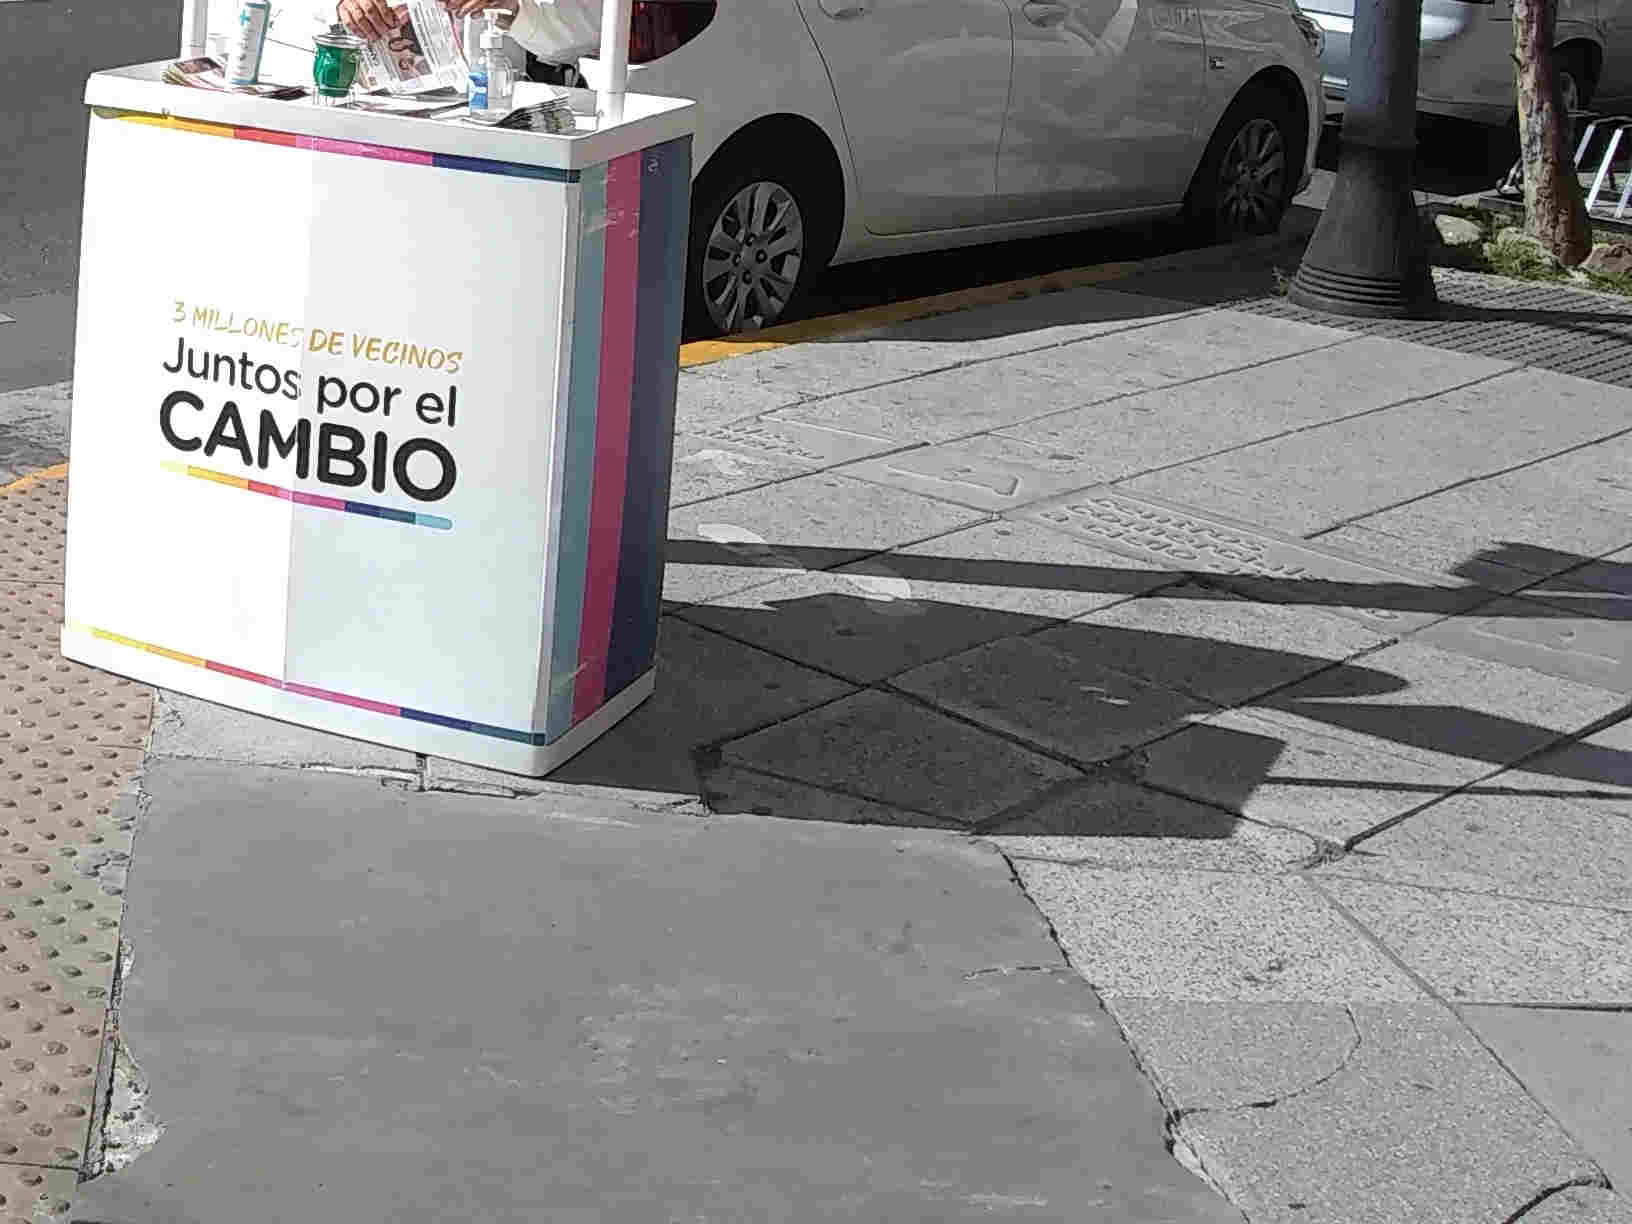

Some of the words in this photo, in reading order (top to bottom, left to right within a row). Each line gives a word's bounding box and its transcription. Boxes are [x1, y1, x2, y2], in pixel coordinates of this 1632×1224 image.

[162, 336, 303, 401] Juntos
[316, 374, 403, 417] por
[415, 384, 458, 428] el
[172, 301, 186, 323] 3
[191, 306, 305, 348] MILLONES
[307, 328, 345, 356] DE
[352, 333, 464, 374] VECINOS
[159, 389, 459, 503] CAMBIO
